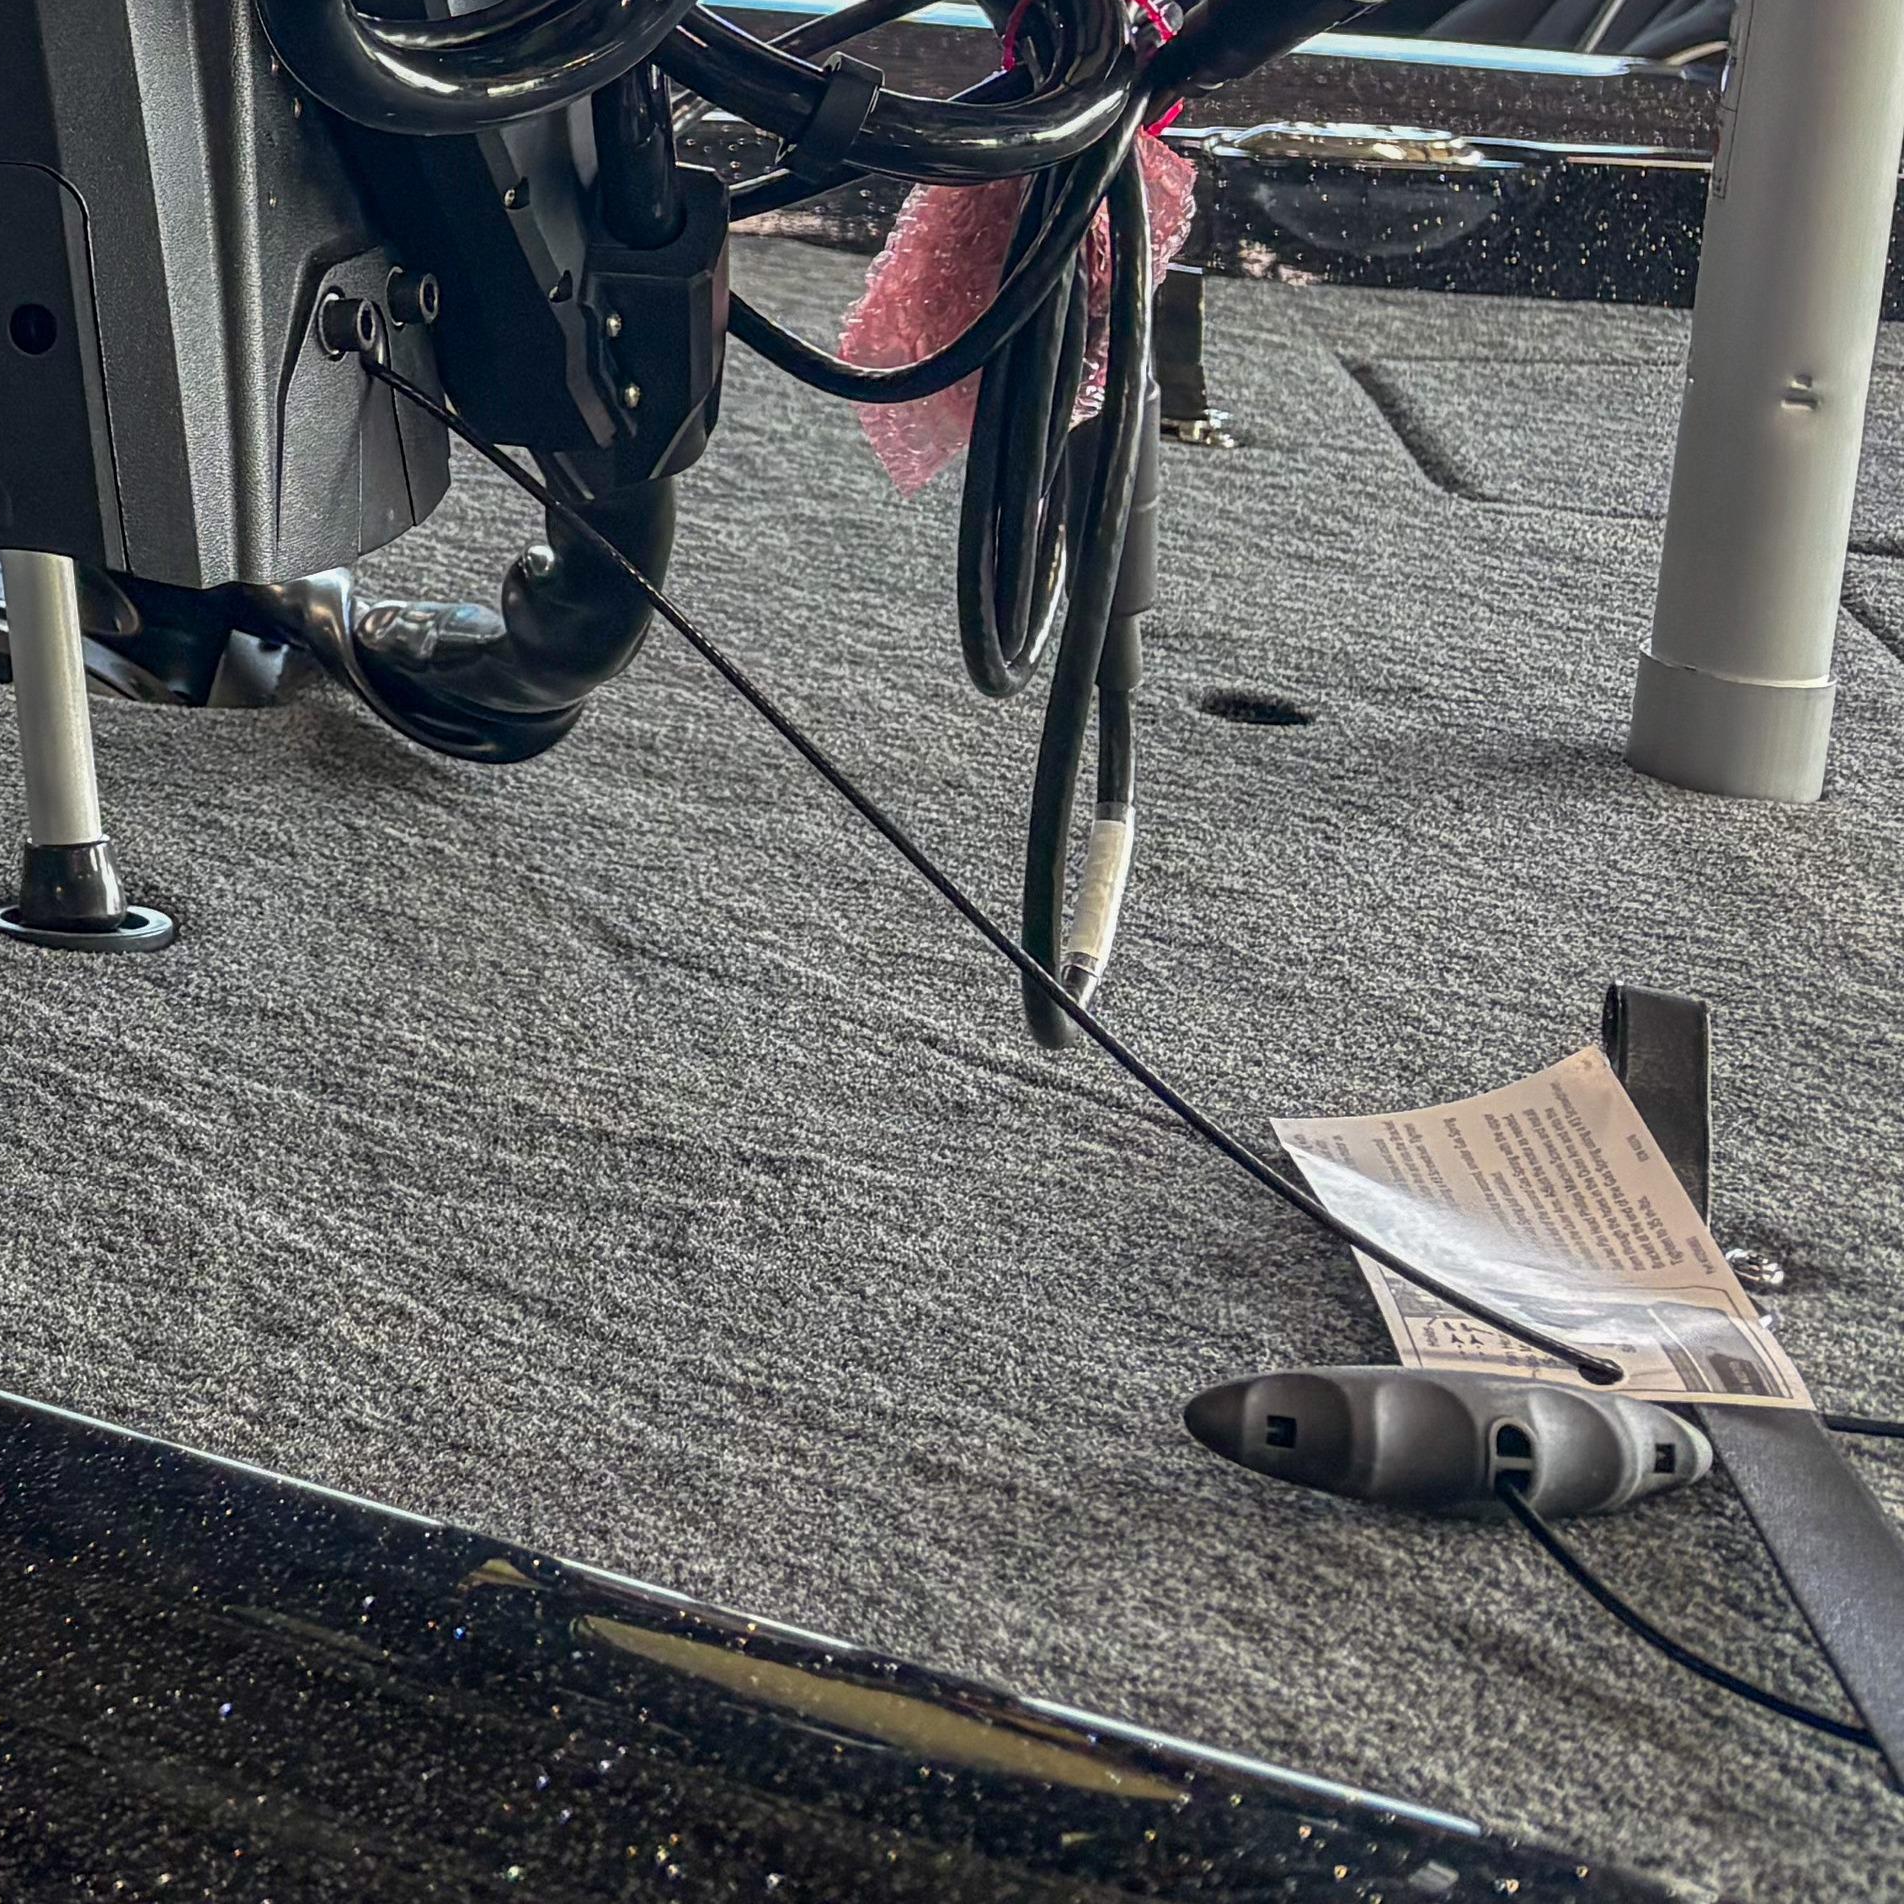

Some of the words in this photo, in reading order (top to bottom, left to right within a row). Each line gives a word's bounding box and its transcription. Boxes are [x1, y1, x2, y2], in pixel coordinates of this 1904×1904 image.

[1568, 1158, 1592, 1177] Outer
[1583, 1147, 1613, 1172] Spring
[1580, 1176, 1599, 1190] the
[1597, 1170, 1618, 1187] Gas
[1606, 1185, 1626, 1199] the
[1619, 1206, 1639, 1222] end
[1603, 1216, 1622, 1230] the
[1627, 1221, 1645, 1234] the
[1637, 1242, 1666, 1269] Bracket
[1655, 1236, 1687, 1265] Tighten
